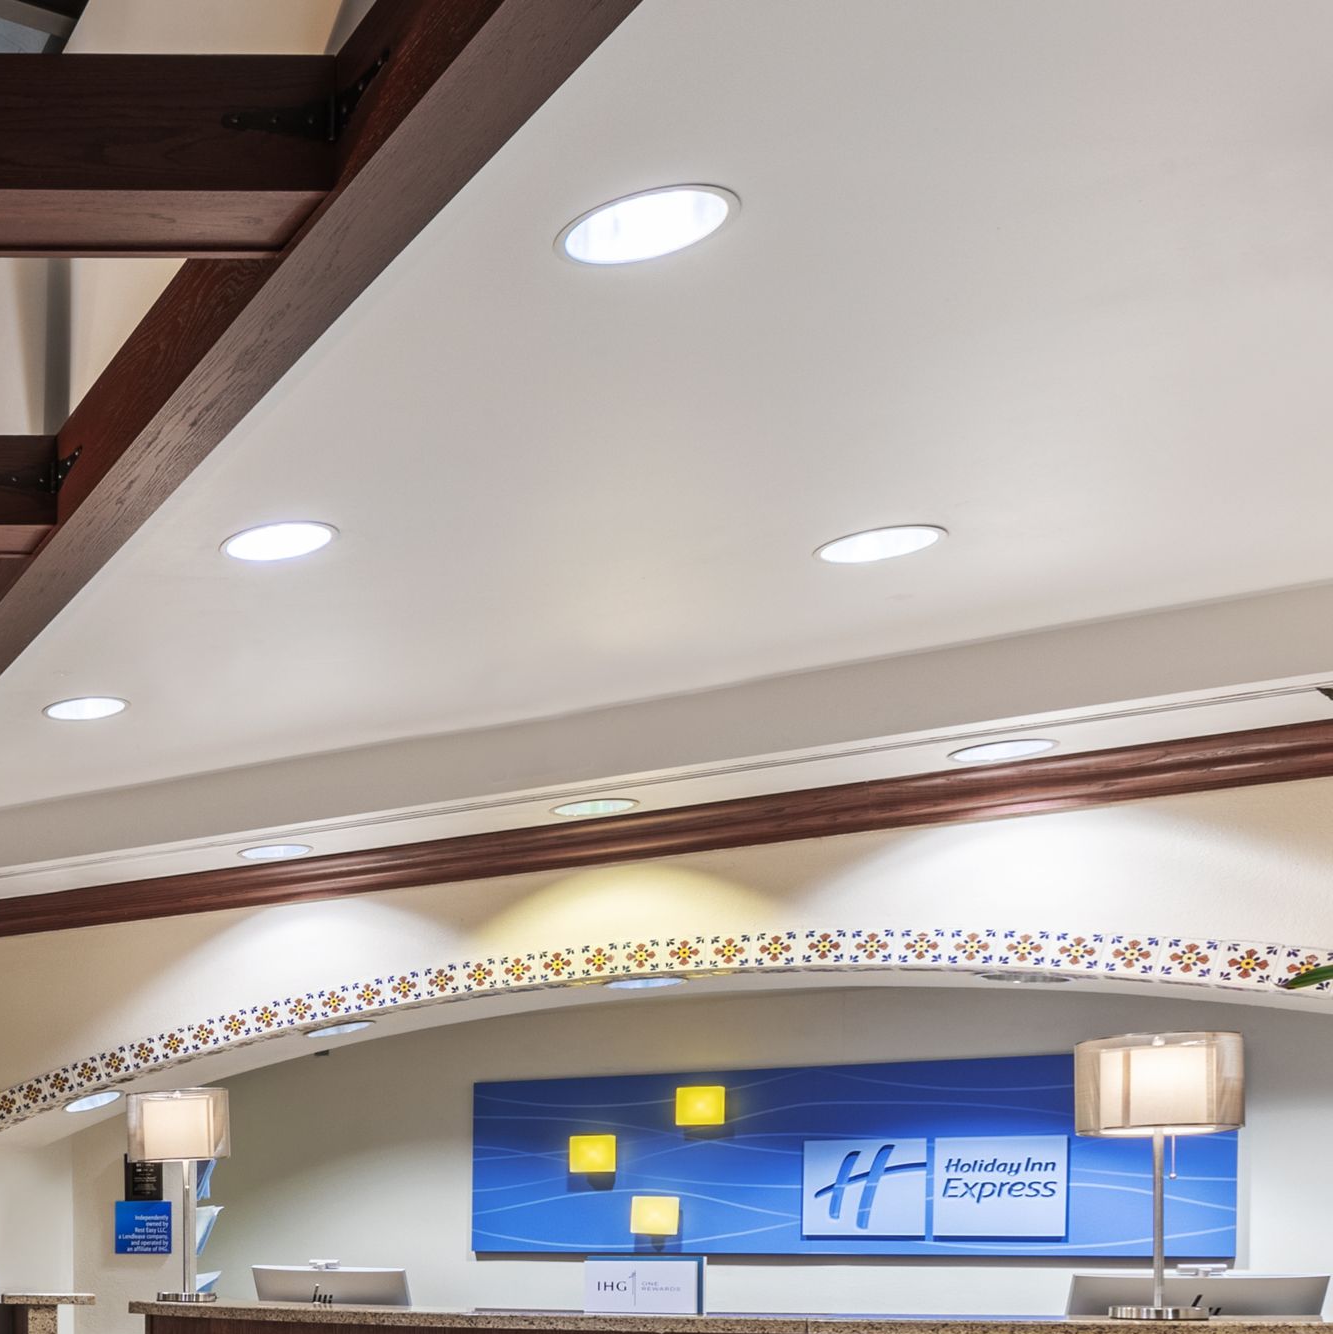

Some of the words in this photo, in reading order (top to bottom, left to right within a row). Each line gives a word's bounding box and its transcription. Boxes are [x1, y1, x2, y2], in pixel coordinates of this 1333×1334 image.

[945, 1158, 1021, 1176] Holiday
[1024, 1157, 1056, 1172] Inn
[942, 1178, 1057, 1203] Express
[598, 1281, 627, 1292] IHG
